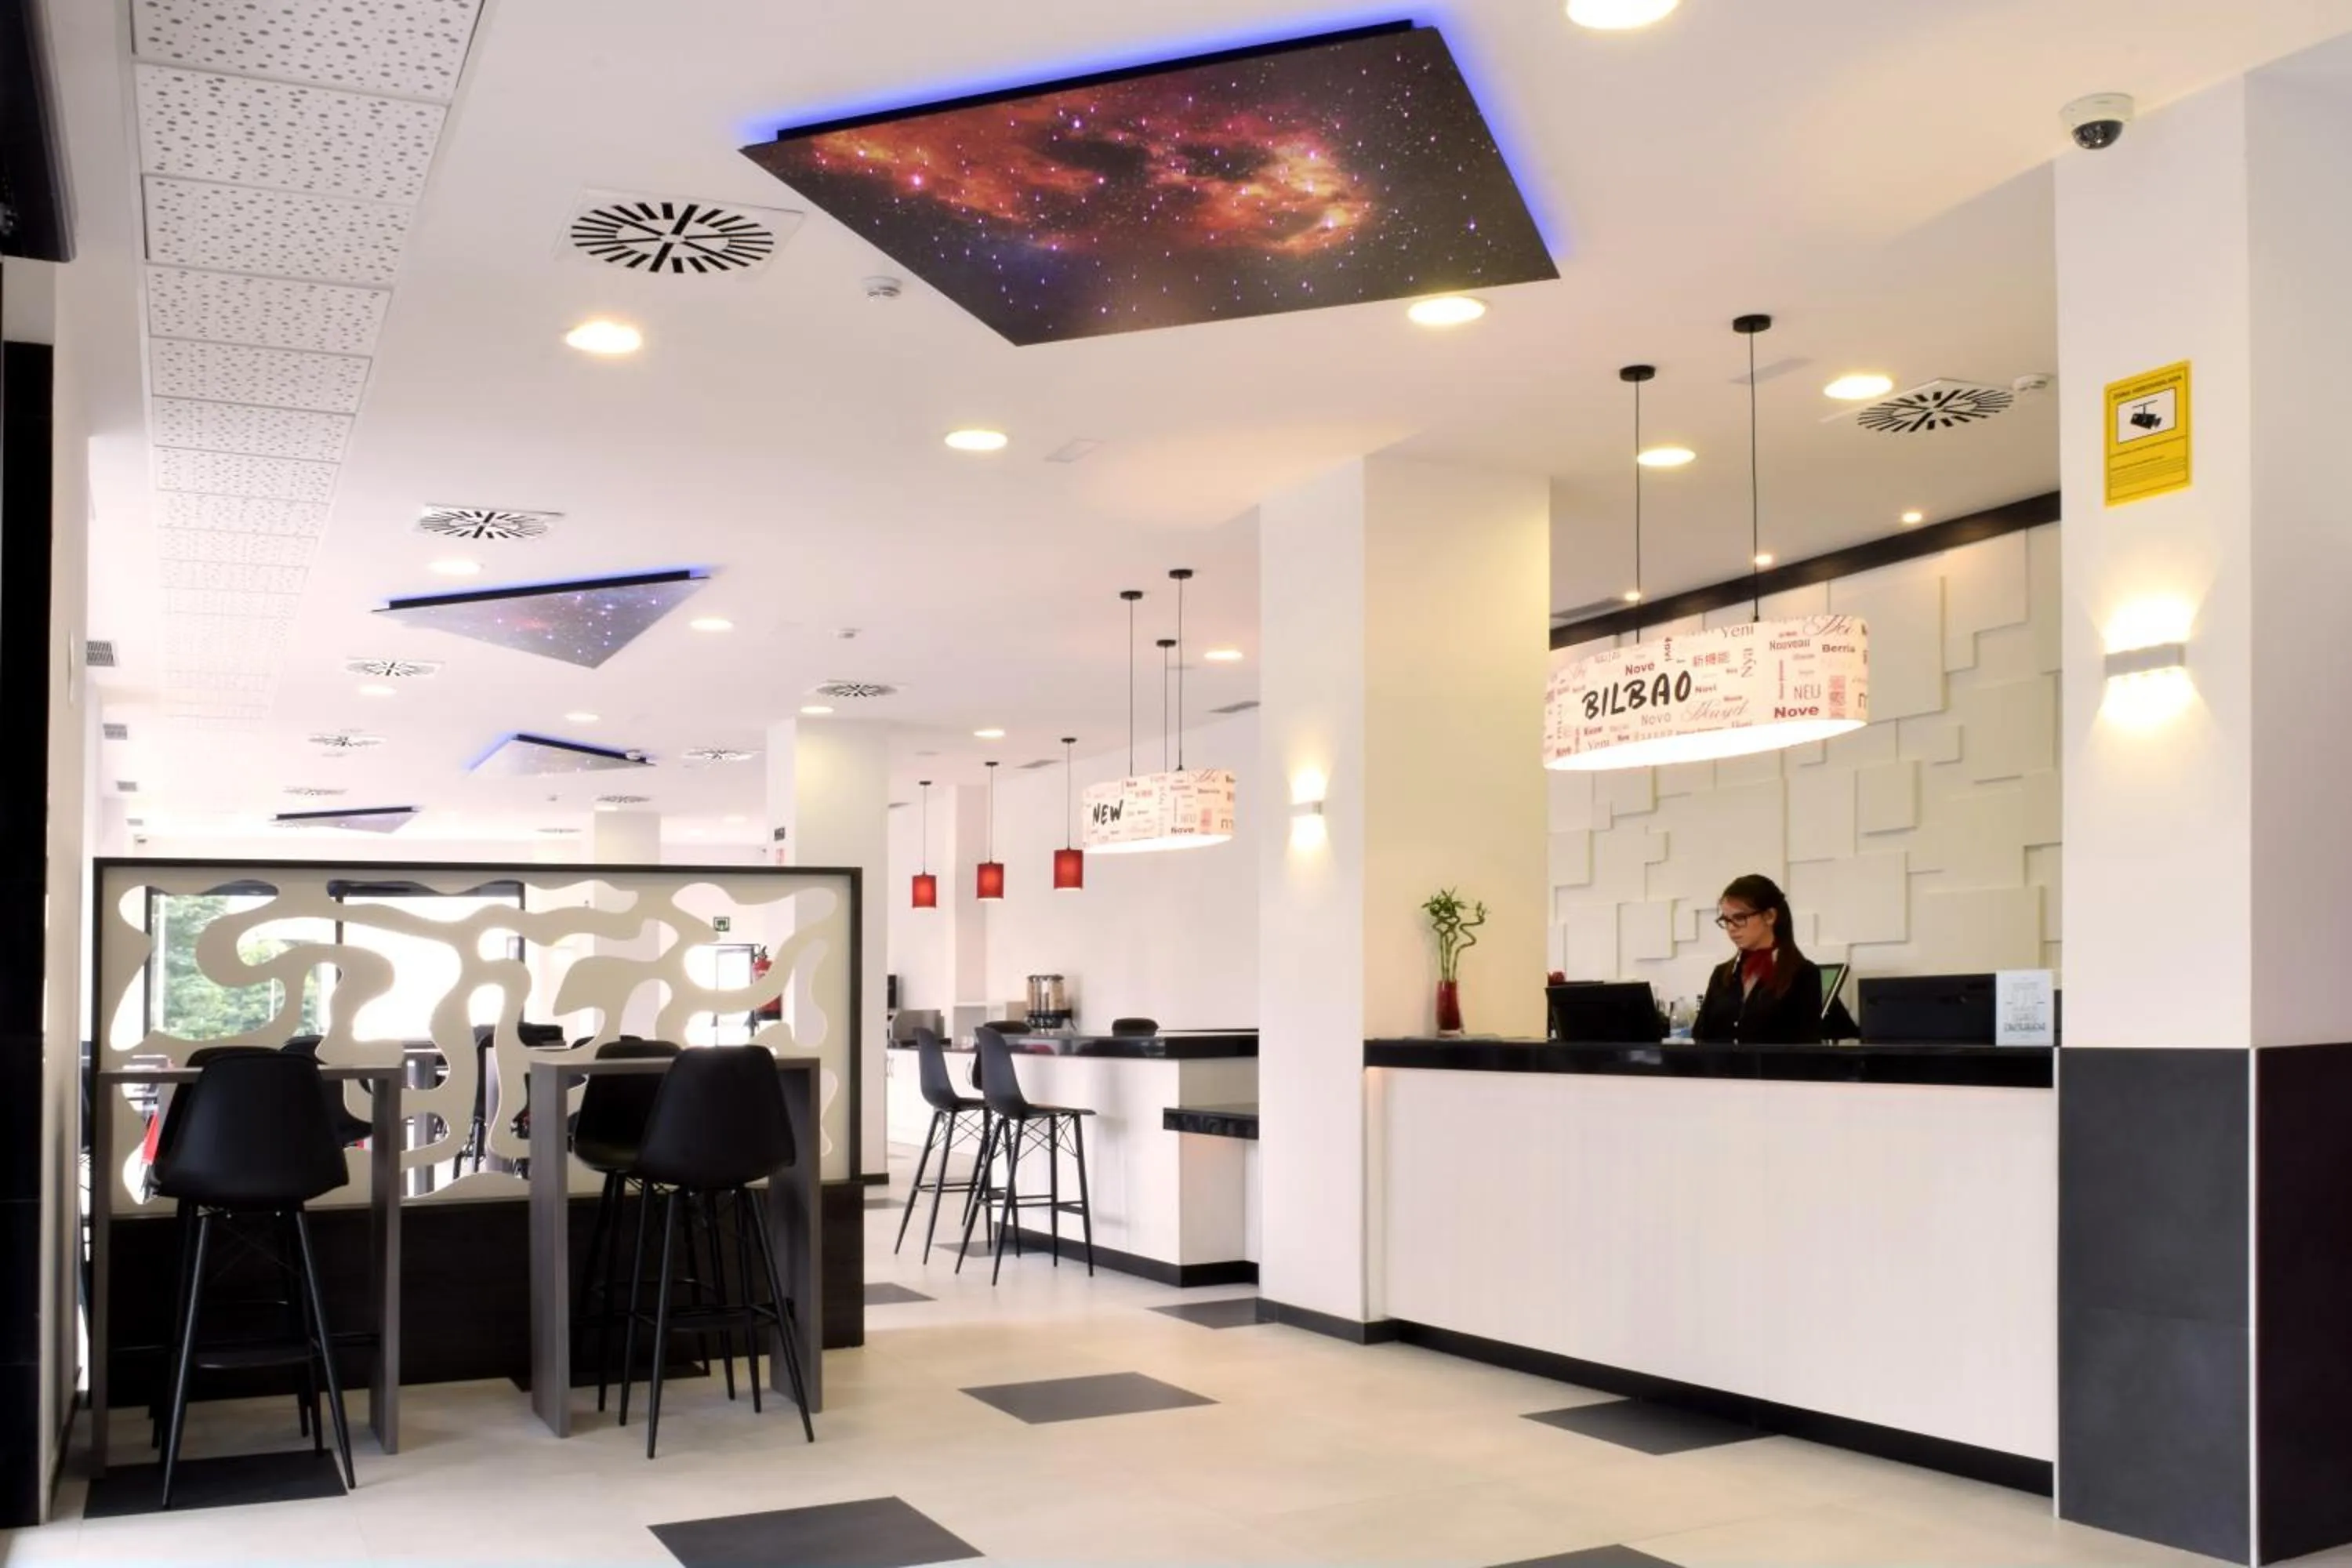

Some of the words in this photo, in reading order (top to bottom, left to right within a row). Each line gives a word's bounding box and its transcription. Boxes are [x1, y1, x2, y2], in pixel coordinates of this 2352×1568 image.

[1581, 670, 1692, 720] BILBAO
[1794, 683, 1821, 700] NEU
[1774, 706, 1820, 719] Nove
[1092, 799, 1124, 826] NEW
